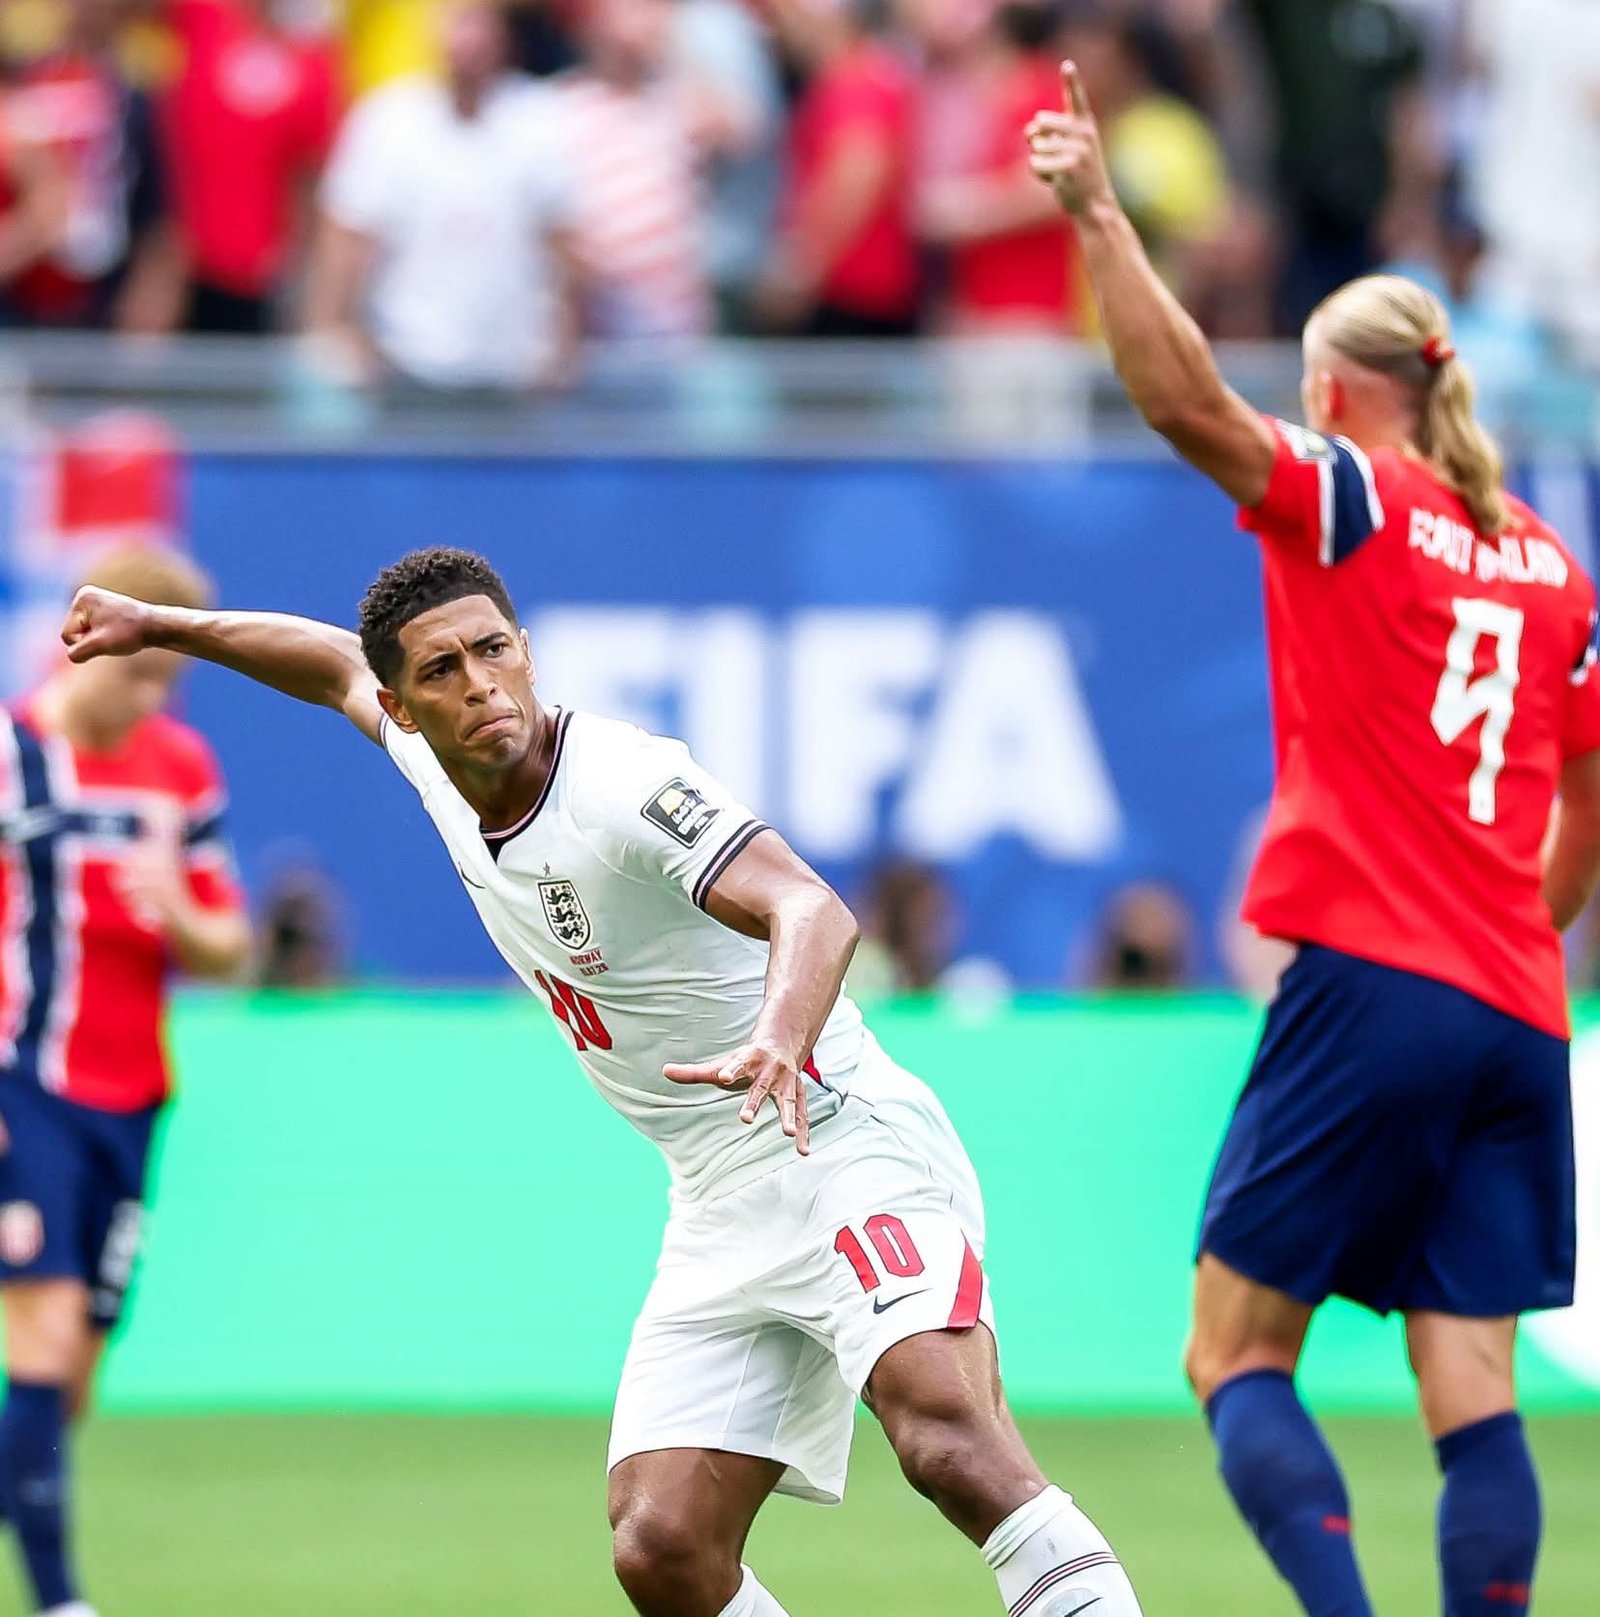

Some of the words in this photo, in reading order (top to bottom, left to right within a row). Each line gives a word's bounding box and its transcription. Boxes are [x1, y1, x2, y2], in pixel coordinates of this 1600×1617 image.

[1429, 596, 1524, 826] 9
[534, 969, 613, 1051] 10
[833, 1213, 926, 1294] 10
